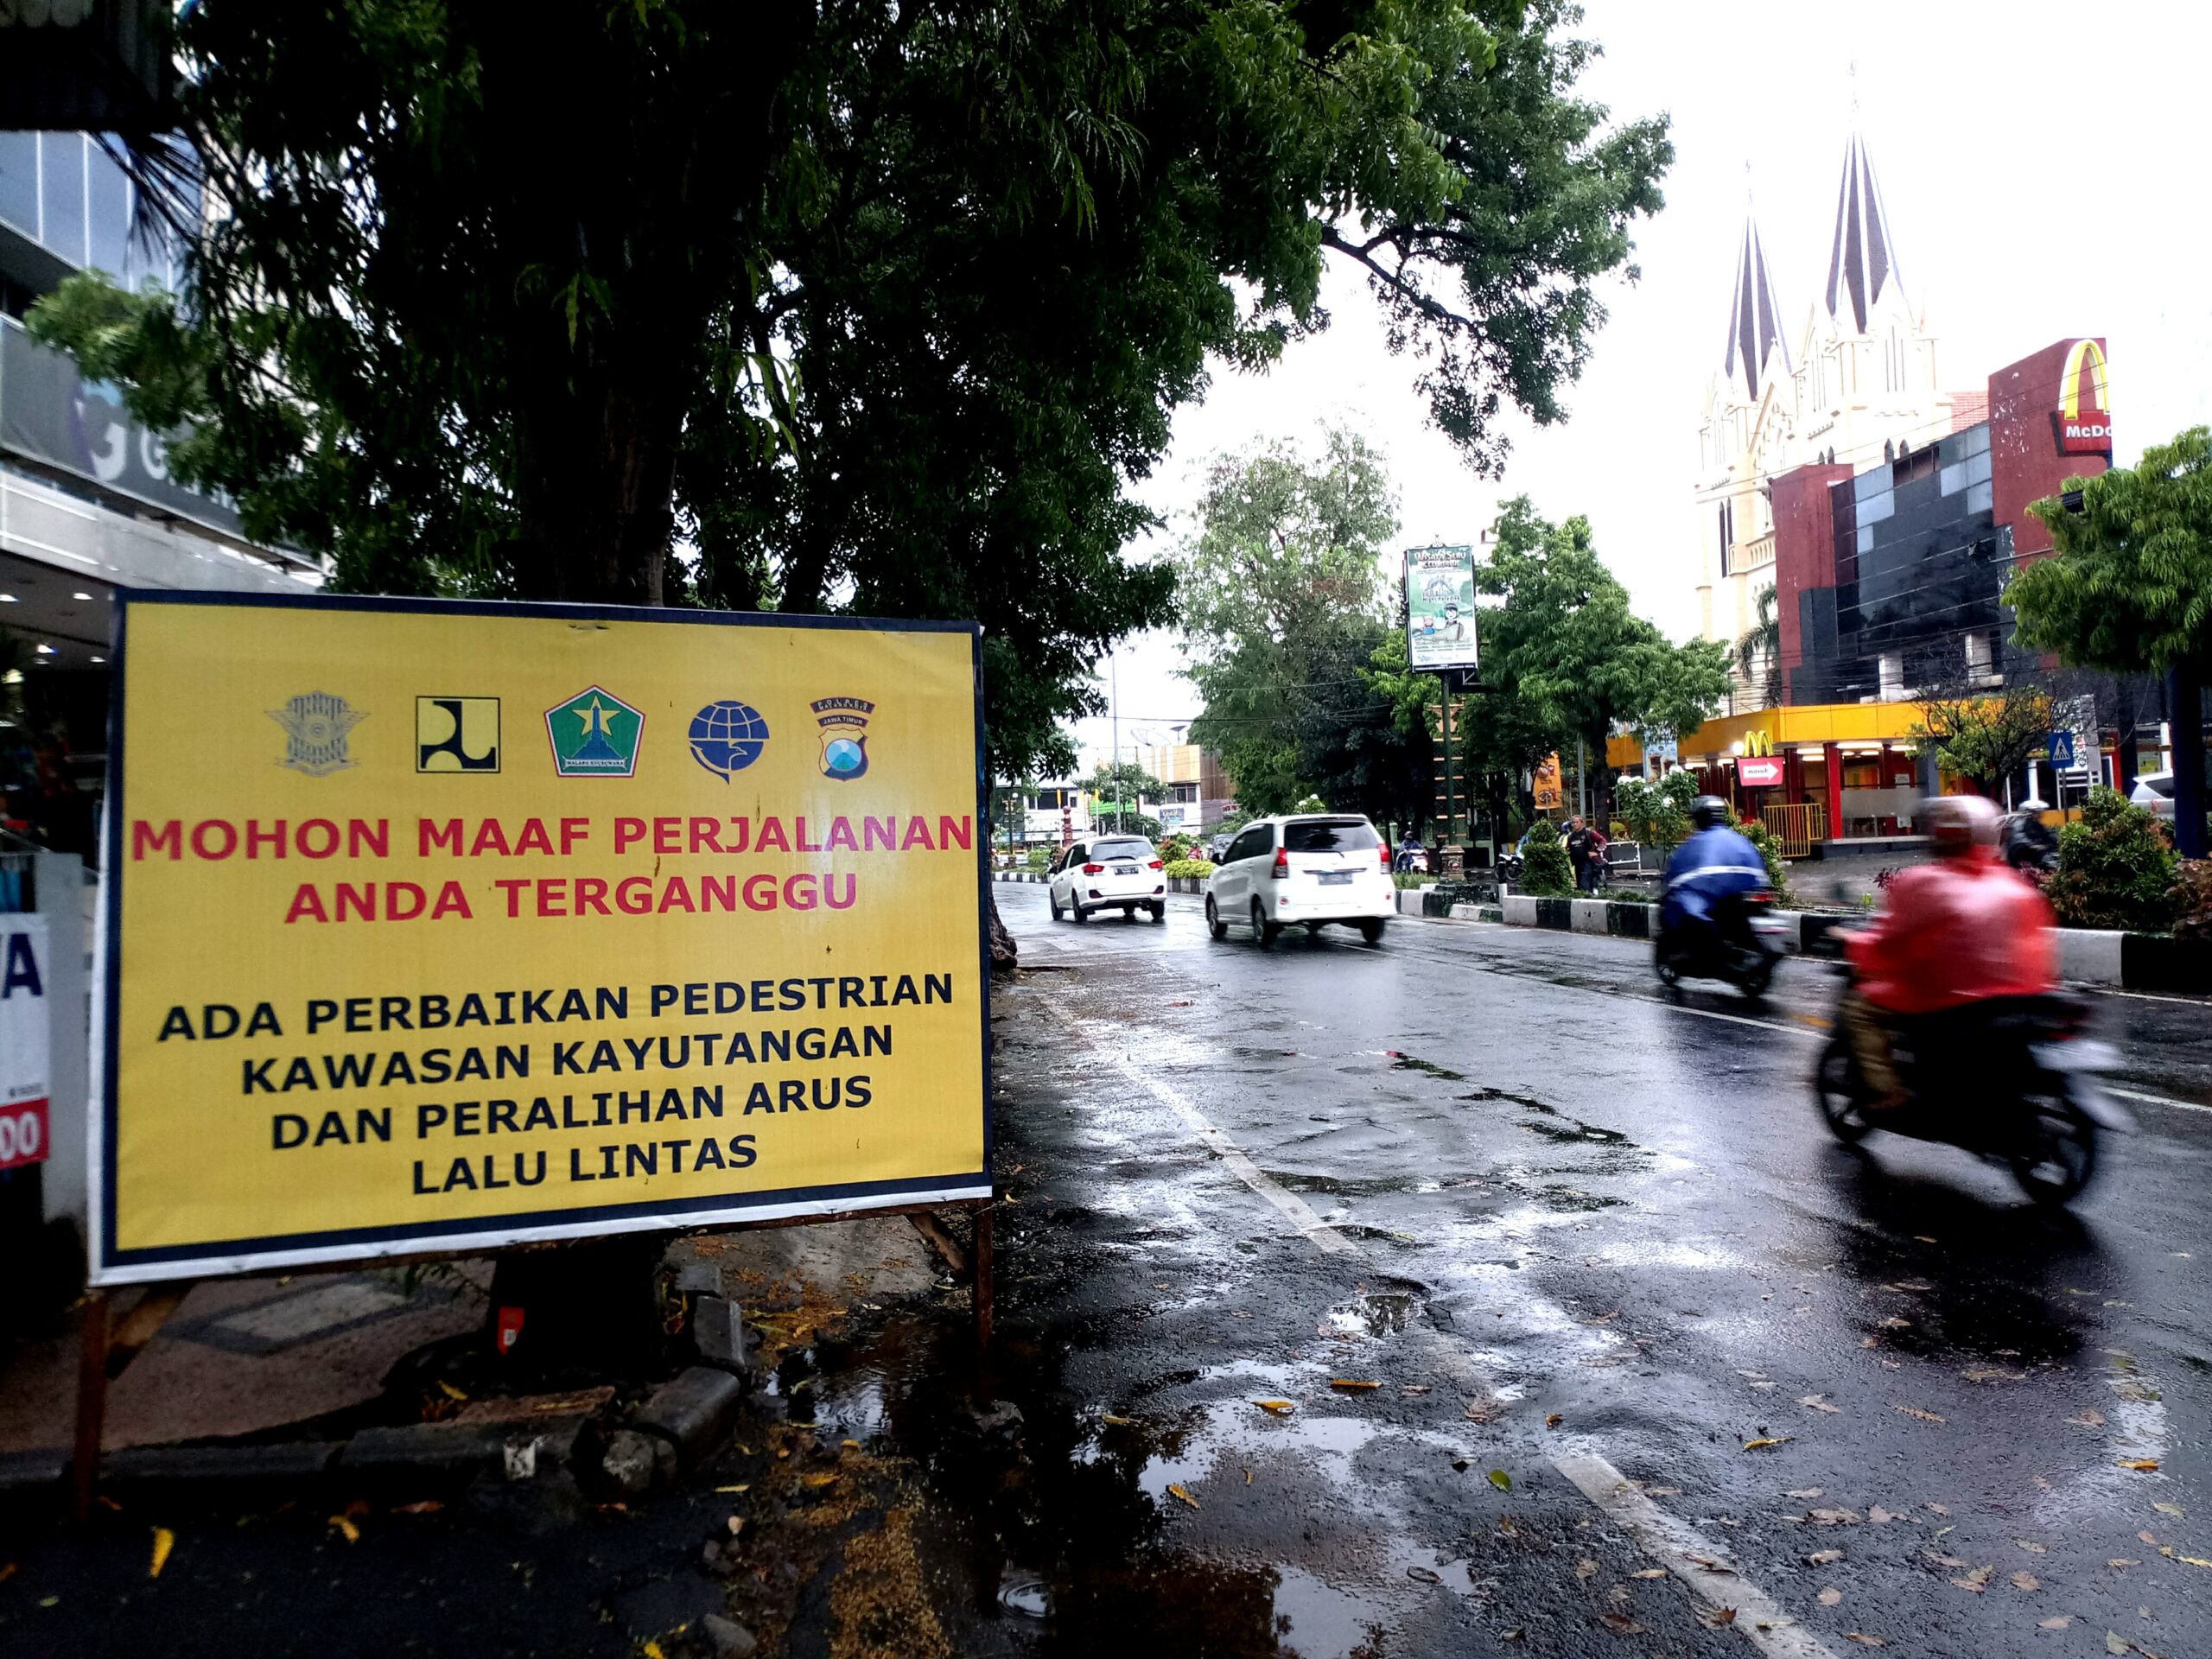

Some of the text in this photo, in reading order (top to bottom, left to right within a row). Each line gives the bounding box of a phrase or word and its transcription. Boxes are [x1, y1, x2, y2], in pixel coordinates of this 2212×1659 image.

[823, 716, 863, 726] JAWA TIMUR
[132, 815, 973, 861] MOHON MAAF PERJALANAN
[286, 873, 857, 924] ANDA TERGANGGU
[157, 973, 953, 1043] ADA PERBAIKAN PEDESTRIAN
[242, 1024, 893, 1095] KAWASAN KAYUTANGAN
[272, 1075, 873, 1150] DAN PERALIHAN ARUS
[413, 1134, 758, 1195] LALU LINTAS
